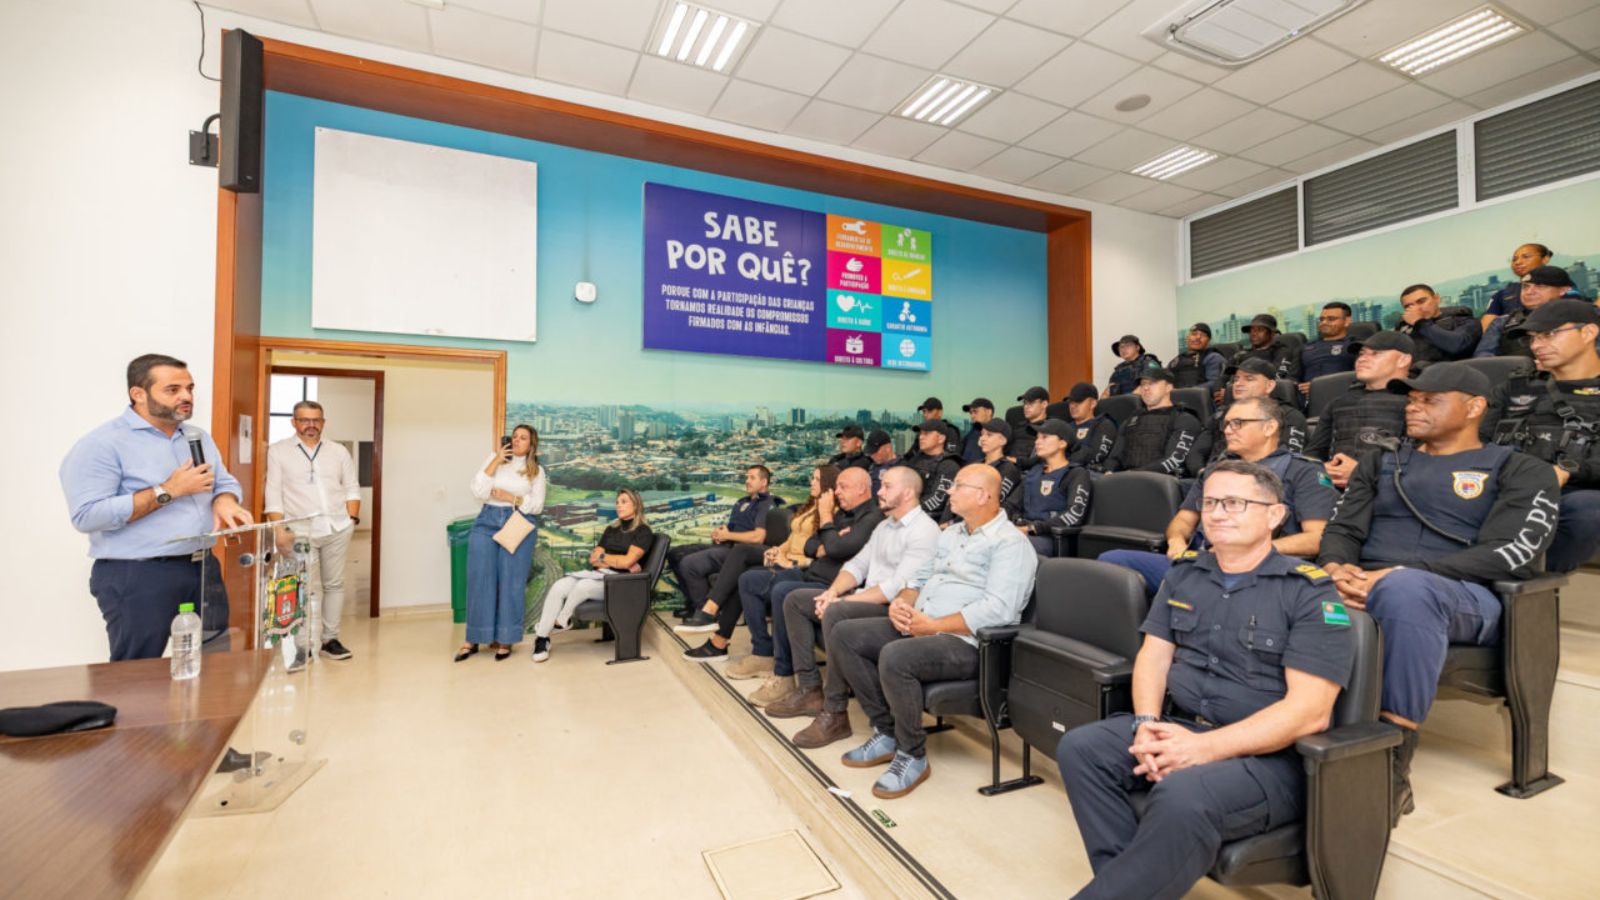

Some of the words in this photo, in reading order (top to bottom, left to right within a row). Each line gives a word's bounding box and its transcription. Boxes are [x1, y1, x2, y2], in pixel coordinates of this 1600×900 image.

[704, 211, 779, 248] SABE
[666, 240, 726, 275] POR
[662, 284, 690, 298] PORQUE
[692, 287, 708, 299] COM
[711, 290, 715, 300] A
[717, 290, 766, 306] PARTICIPAÇÃO
[768, 296, 781, 308] DAS
[783, 298, 814, 311] CRIANÇAS
[665, 299, 705, 313] TORNAMOS
[707, 304, 744, 317] REALIDADE
[746, 308, 755, 318] OS
[757, 309, 809, 323] COMPROMISSOS
[688, 315, 724, 329] FIRMADOS
[727, 319, 742, 331] COM
[744, 321, 753, 332] AS
[755, 321, 791, 335] INFÂNCIAS.
